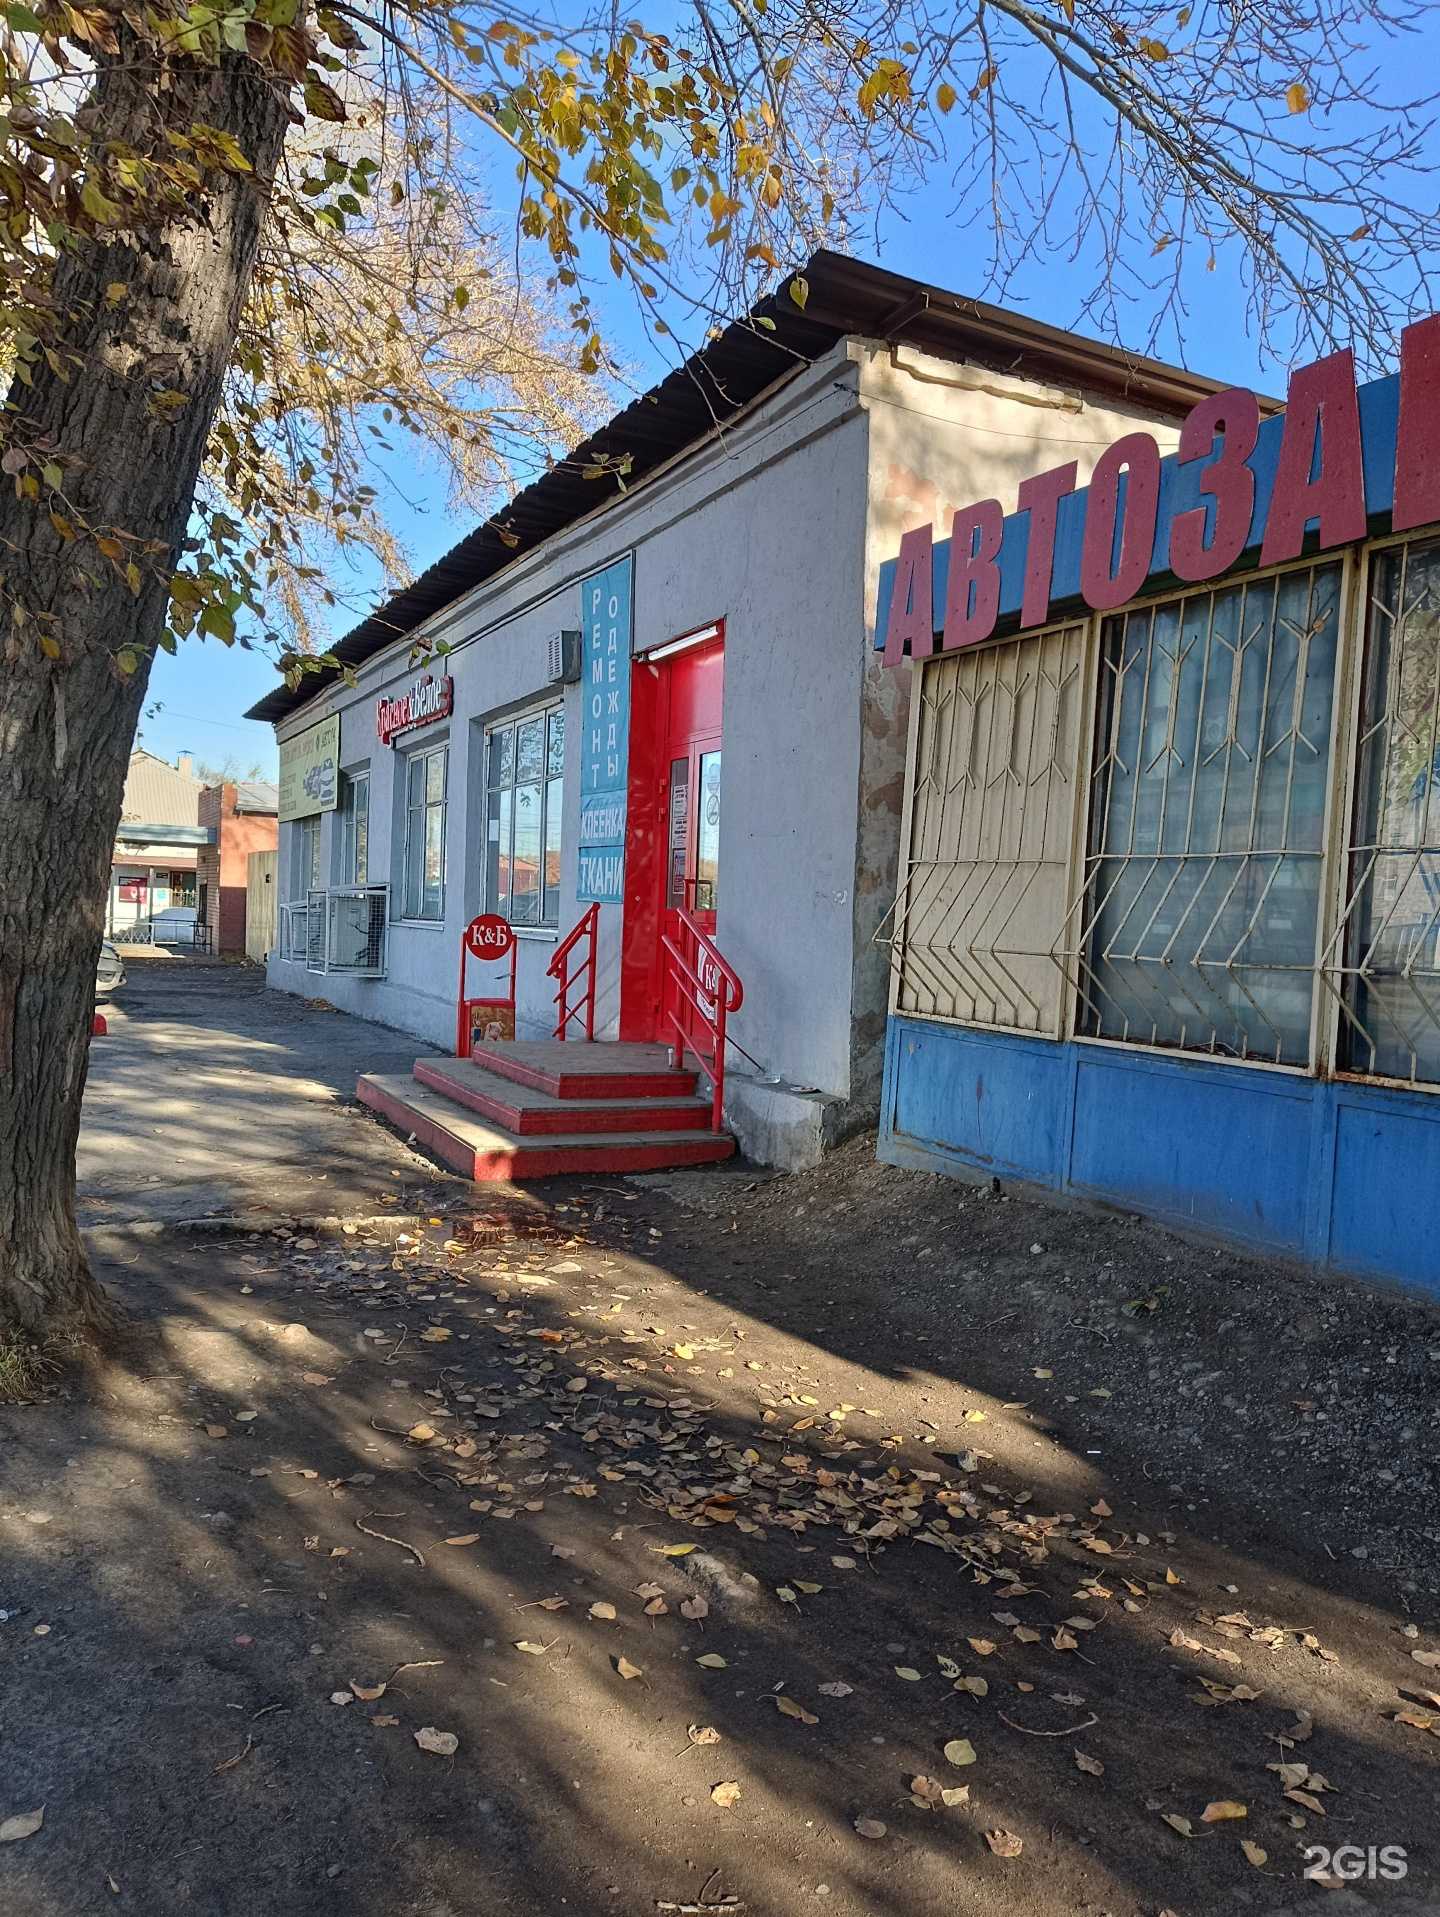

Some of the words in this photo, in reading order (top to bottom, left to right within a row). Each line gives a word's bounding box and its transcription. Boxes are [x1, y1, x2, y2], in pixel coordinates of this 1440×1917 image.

[592, 588, 602, 789] РЕМОНТ
[607, 595, 620, 778] ОДЕЖДЫ
[581, 807, 624, 840] КЛЕЕНКА
[580, 856, 624, 896] ТКАНИ
[471, 924, 507, 947] К&Б
